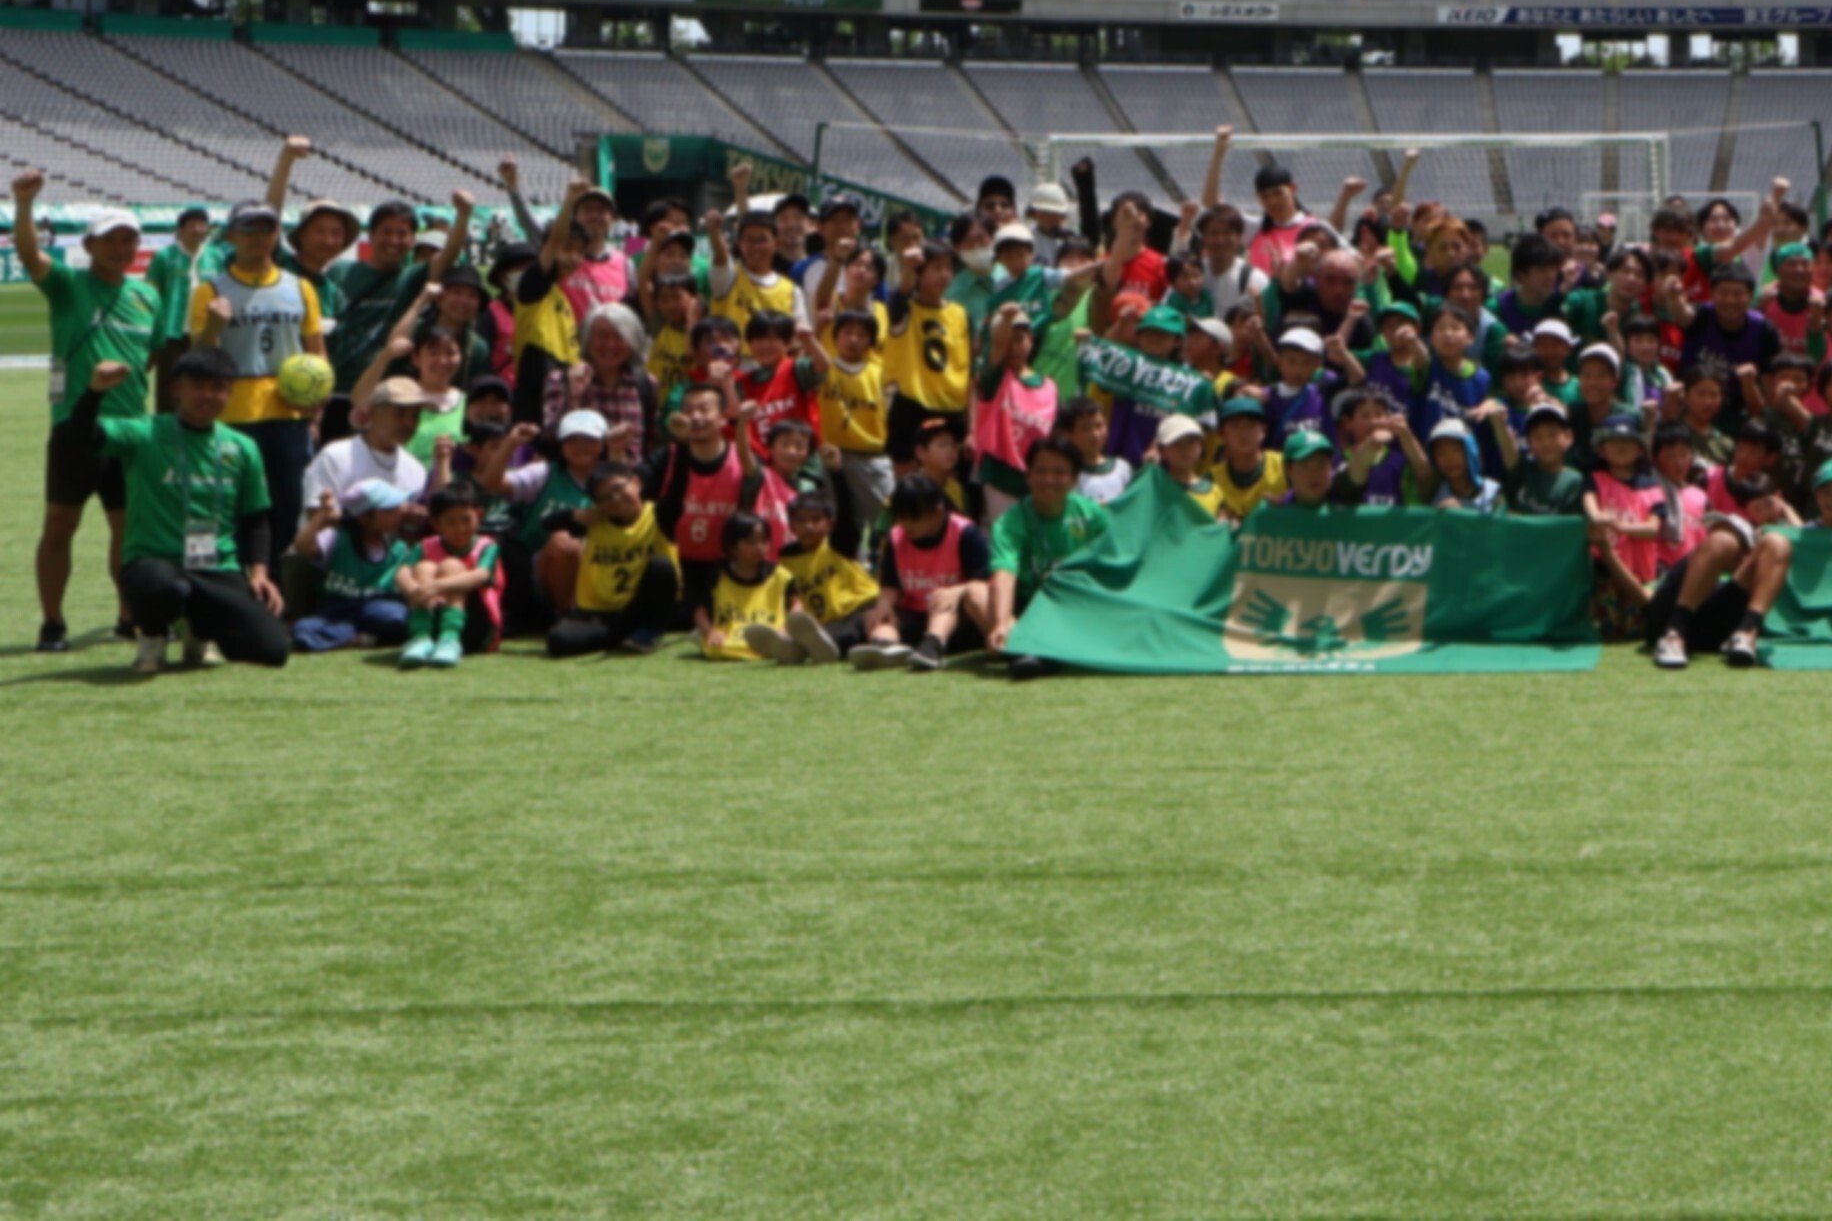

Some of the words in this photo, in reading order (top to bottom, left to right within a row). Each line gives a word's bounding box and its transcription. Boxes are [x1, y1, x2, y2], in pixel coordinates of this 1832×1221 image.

[260, 328, 274, 354] 6
[691, 518, 708, 543] 6
[614, 568, 631, 594] 2
